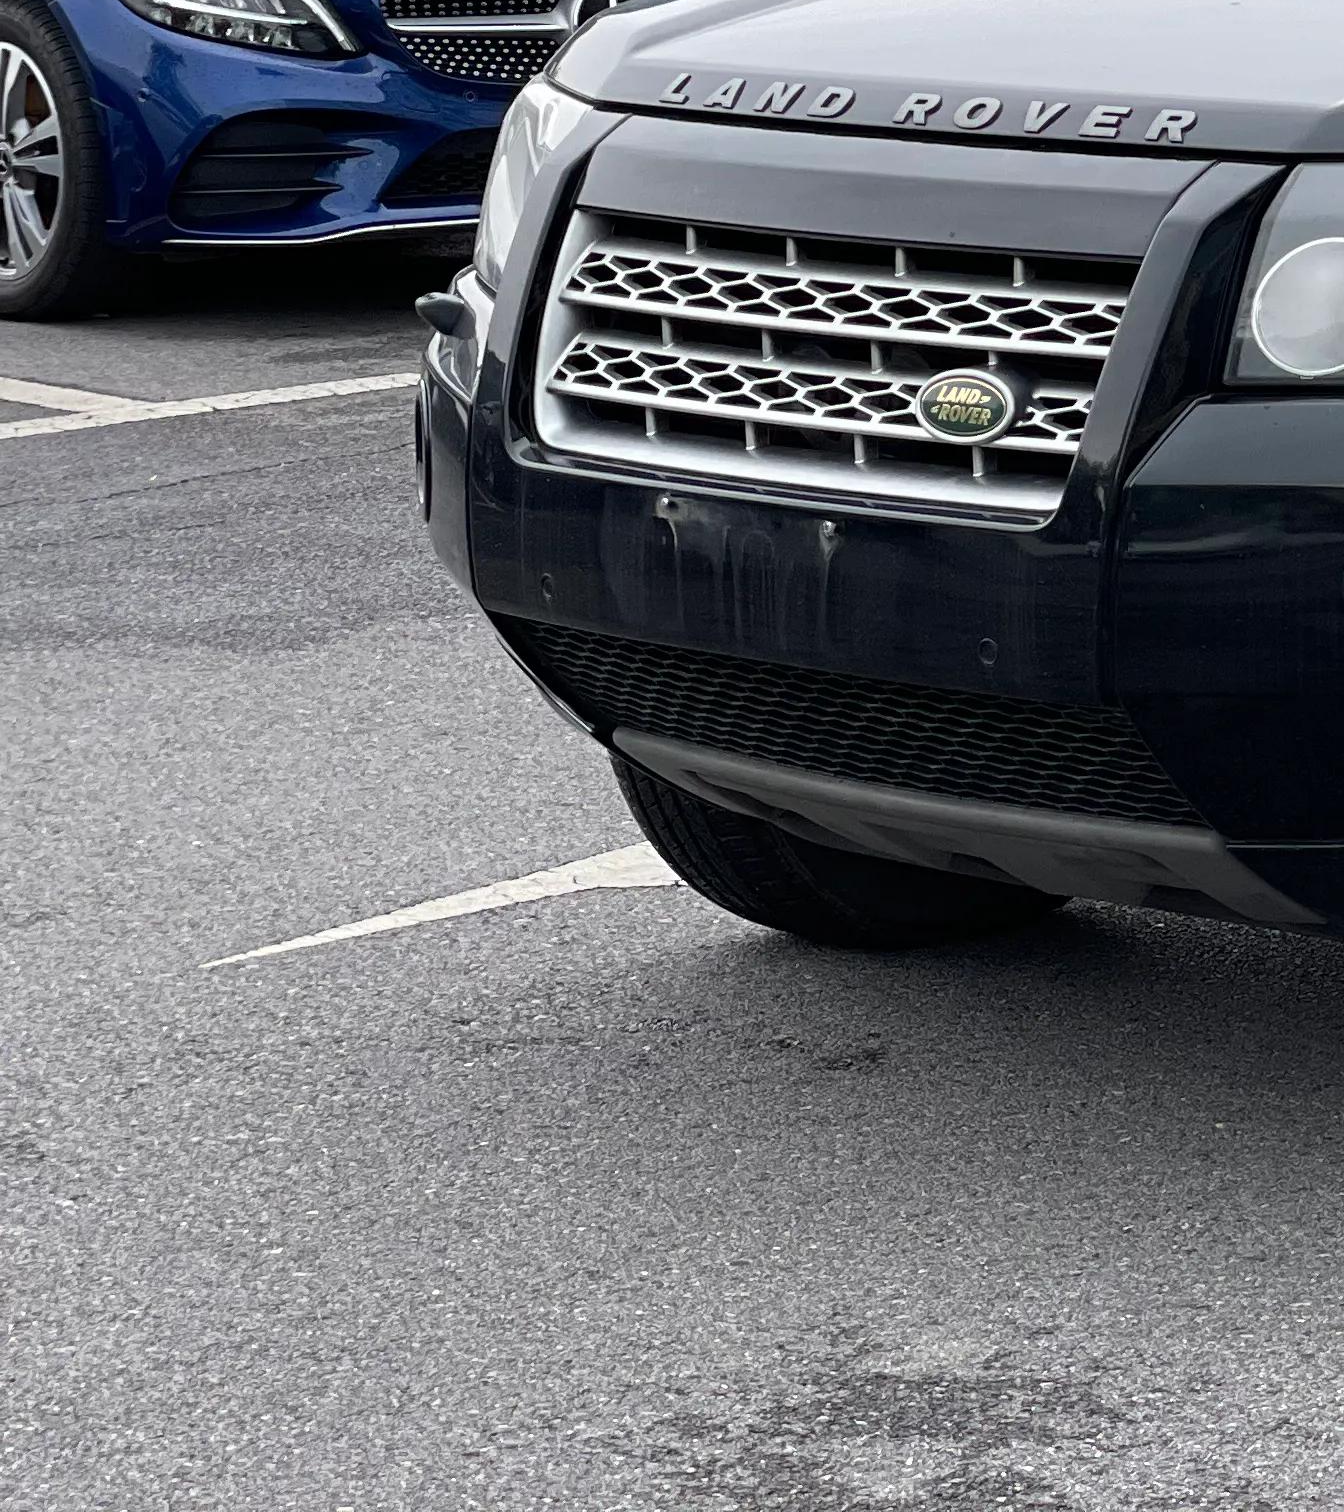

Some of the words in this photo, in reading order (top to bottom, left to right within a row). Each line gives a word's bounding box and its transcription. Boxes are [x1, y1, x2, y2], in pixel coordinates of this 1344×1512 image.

[659, 72, 857, 119] LAND
[893, 92, 1198, 143] ROVER
[936, 386, 982, 404] LAND
[937, 404, 992, 425] ROVER
